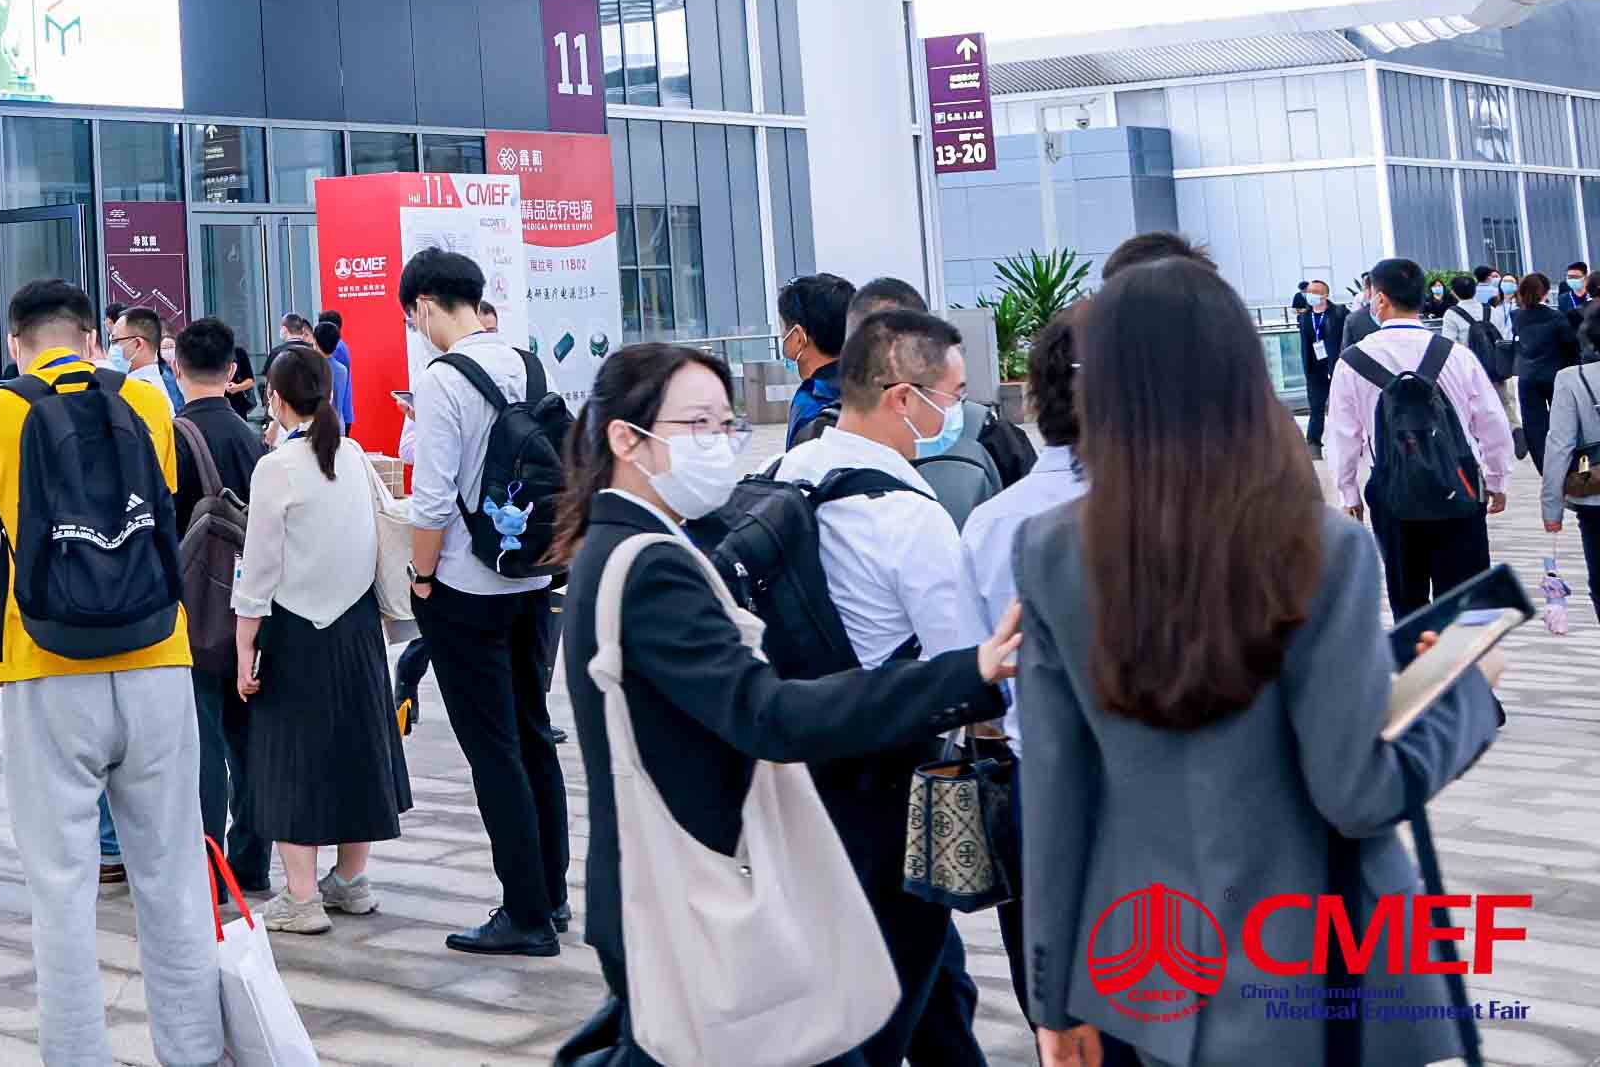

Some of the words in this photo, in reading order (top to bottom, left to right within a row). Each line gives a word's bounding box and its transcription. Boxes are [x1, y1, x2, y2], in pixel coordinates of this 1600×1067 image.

[553, 32, 593, 96] 11
[936, 143, 987, 165] 13-20
[422, 175, 442, 205] 11
[465, 182, 512, 206] CMEF
[521, 199, 593, 221] 精品医疗电源
[550, 223, 571, 231] POWER
[572, 223, 593, 231] SUPPLY
[352, 256, 386, 271] CMEF
[560, 259, 587, 271] 11B02
